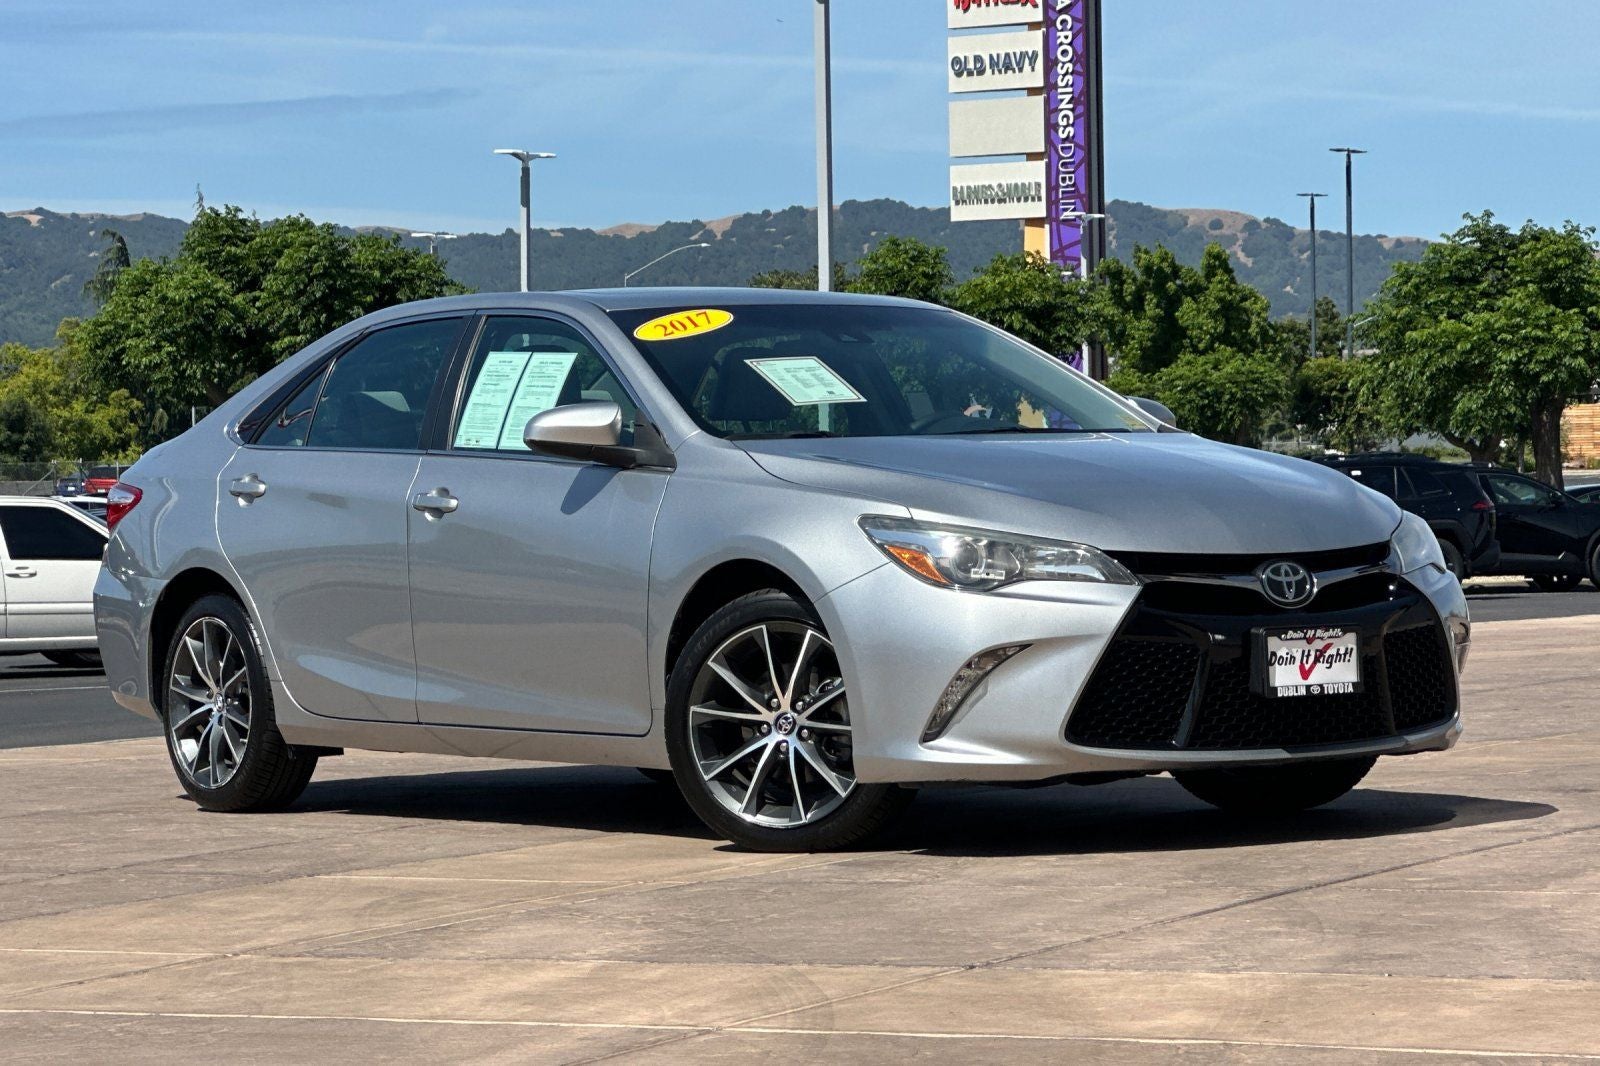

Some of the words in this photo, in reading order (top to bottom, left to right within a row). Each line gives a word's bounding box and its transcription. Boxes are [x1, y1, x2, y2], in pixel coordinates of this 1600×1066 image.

[951, 54, 986, 76] OLD
[989, 50, 1039, 74] NAVY
[1056, 14, 1074, 139] CROSSINGS
[1058, 143, 1075, 221] DUBLIN
[654, 311, 711, 337] 2017
[1300, 648, 1311, 665] It
[1313, 647, 1354, 669] Right!
[1277, 685, 1306, 697] DUBLIN
[1322, 682, 1354, 694] TOYOTA
